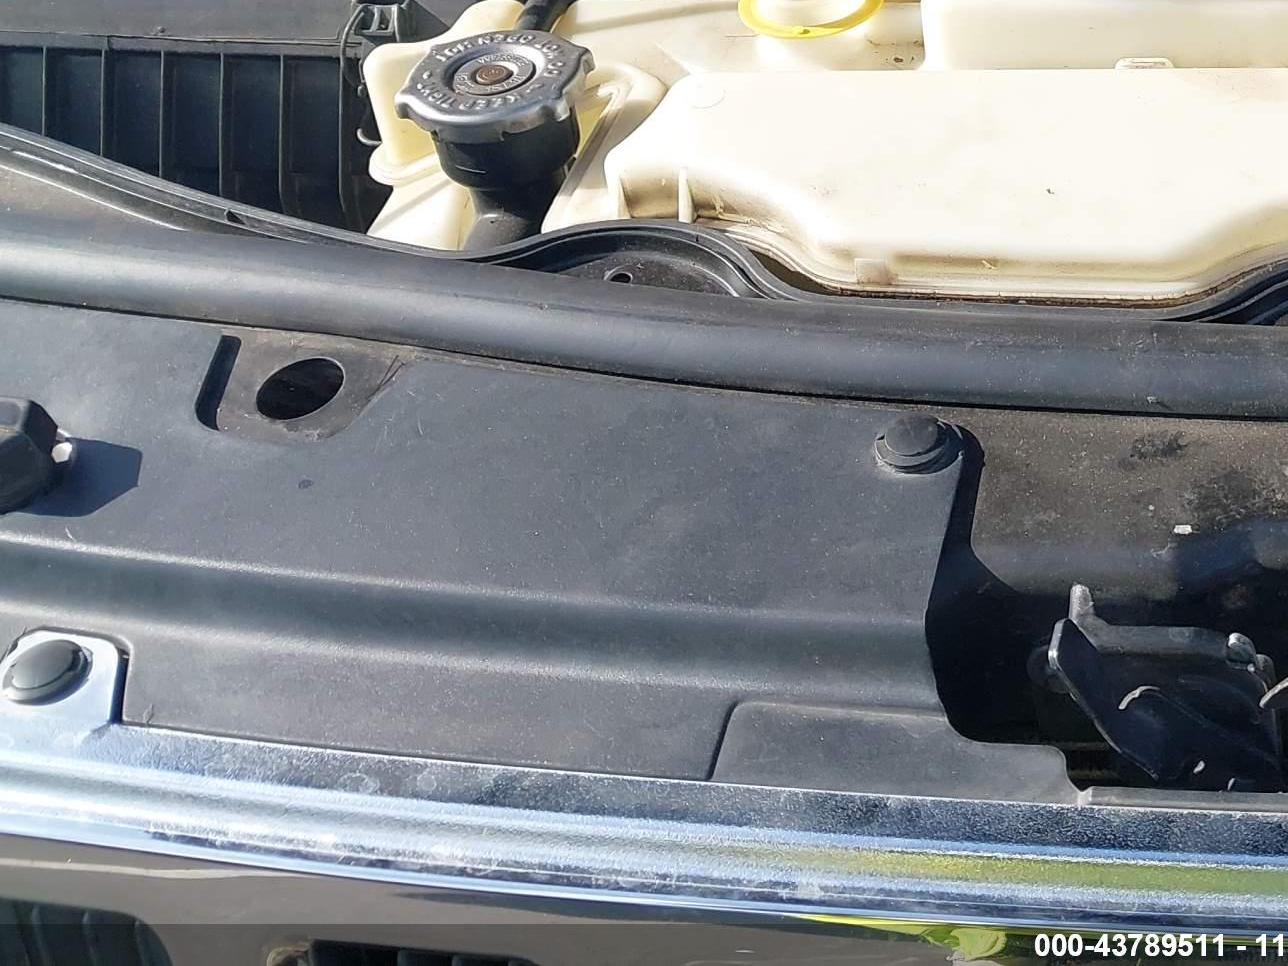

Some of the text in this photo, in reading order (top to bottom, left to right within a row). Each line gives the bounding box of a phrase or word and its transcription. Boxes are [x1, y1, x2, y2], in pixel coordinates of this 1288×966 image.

[477, 34, 533, 46] OPEN
[416, 81, 457, 109] TIGHT
[458, 92, 523, 111] KEEP
